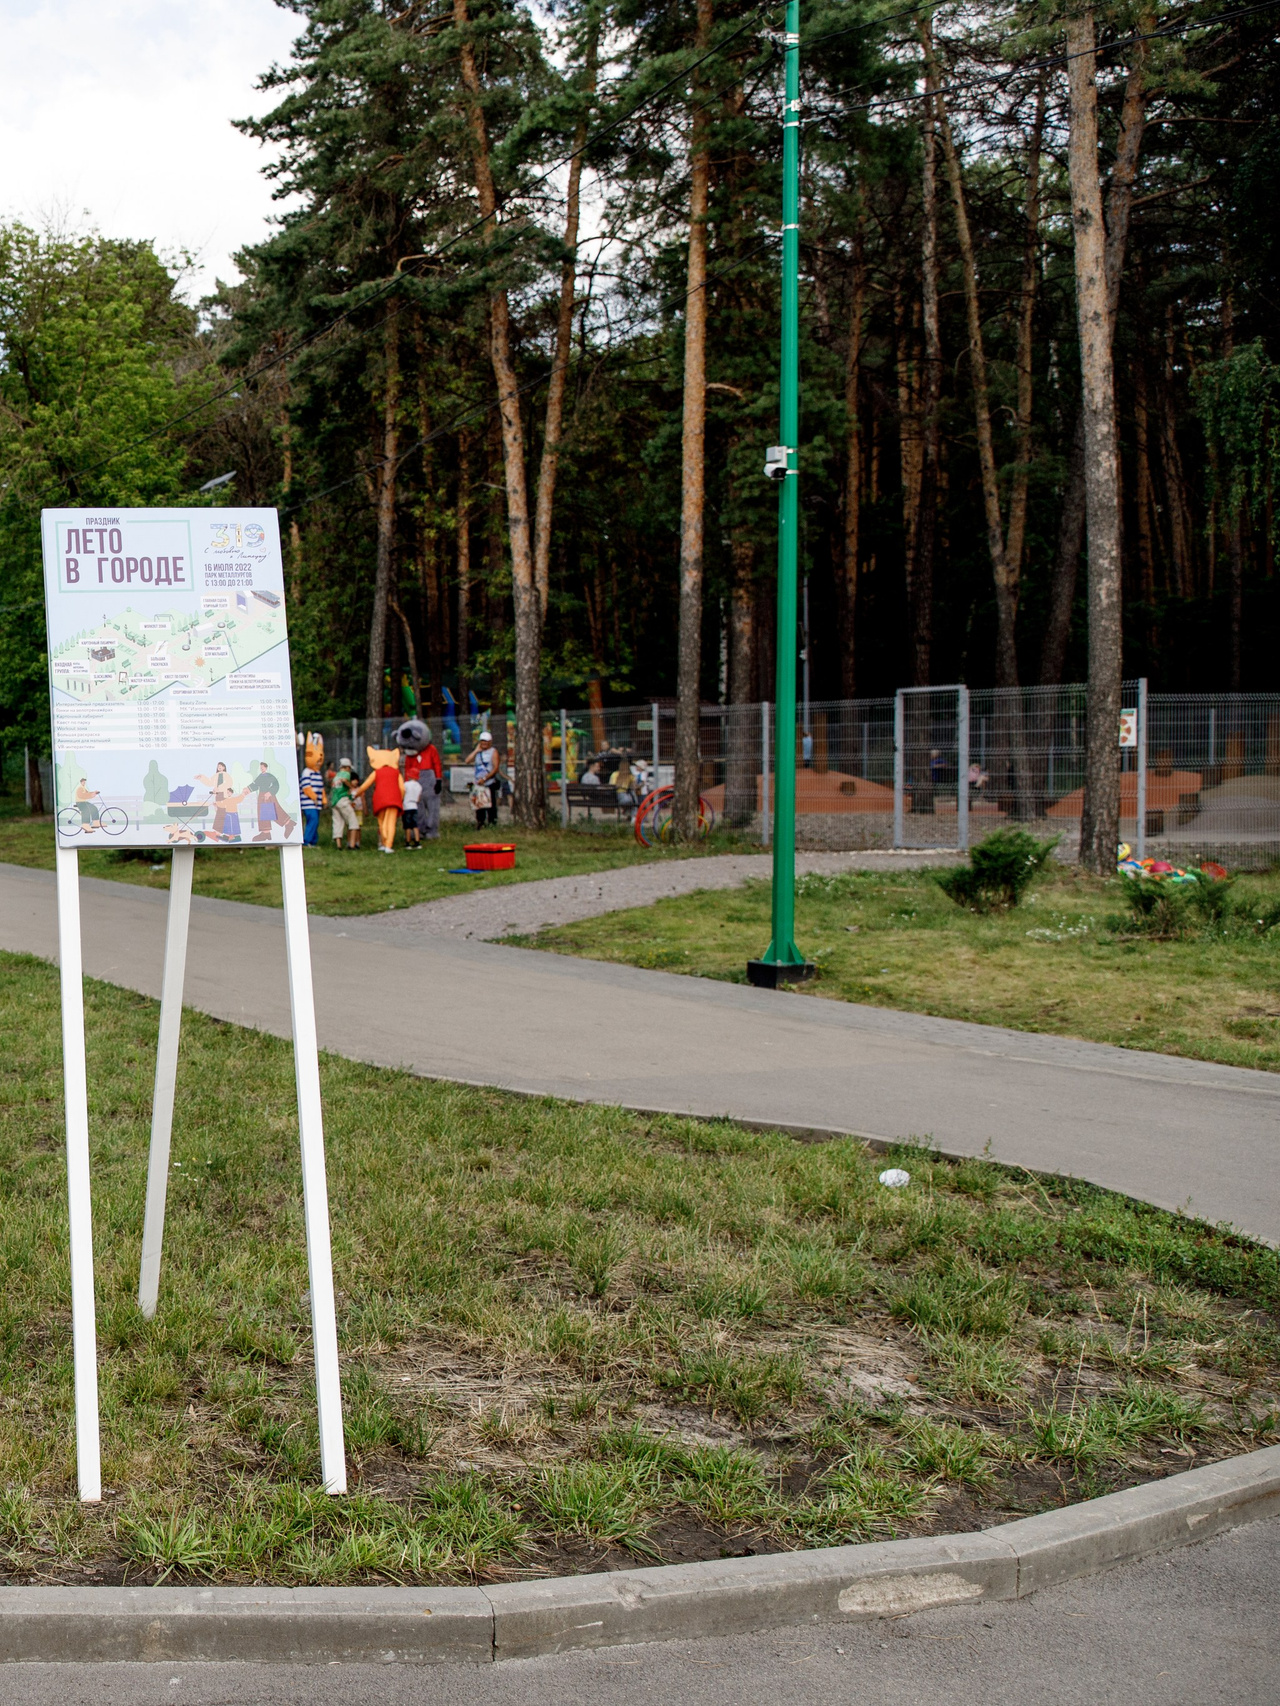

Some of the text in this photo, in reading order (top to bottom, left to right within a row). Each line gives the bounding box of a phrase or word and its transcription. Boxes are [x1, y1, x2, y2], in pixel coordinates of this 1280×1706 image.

[85, 517, 120, 526] ПРАЗДНИК
[65, 528, 123, 554] ЛЕТО
[209, 523, 265, 548] 319
[65, 556, 186, 586] В ГОРОДЕ
[235, 563, 252, 571] 2022
